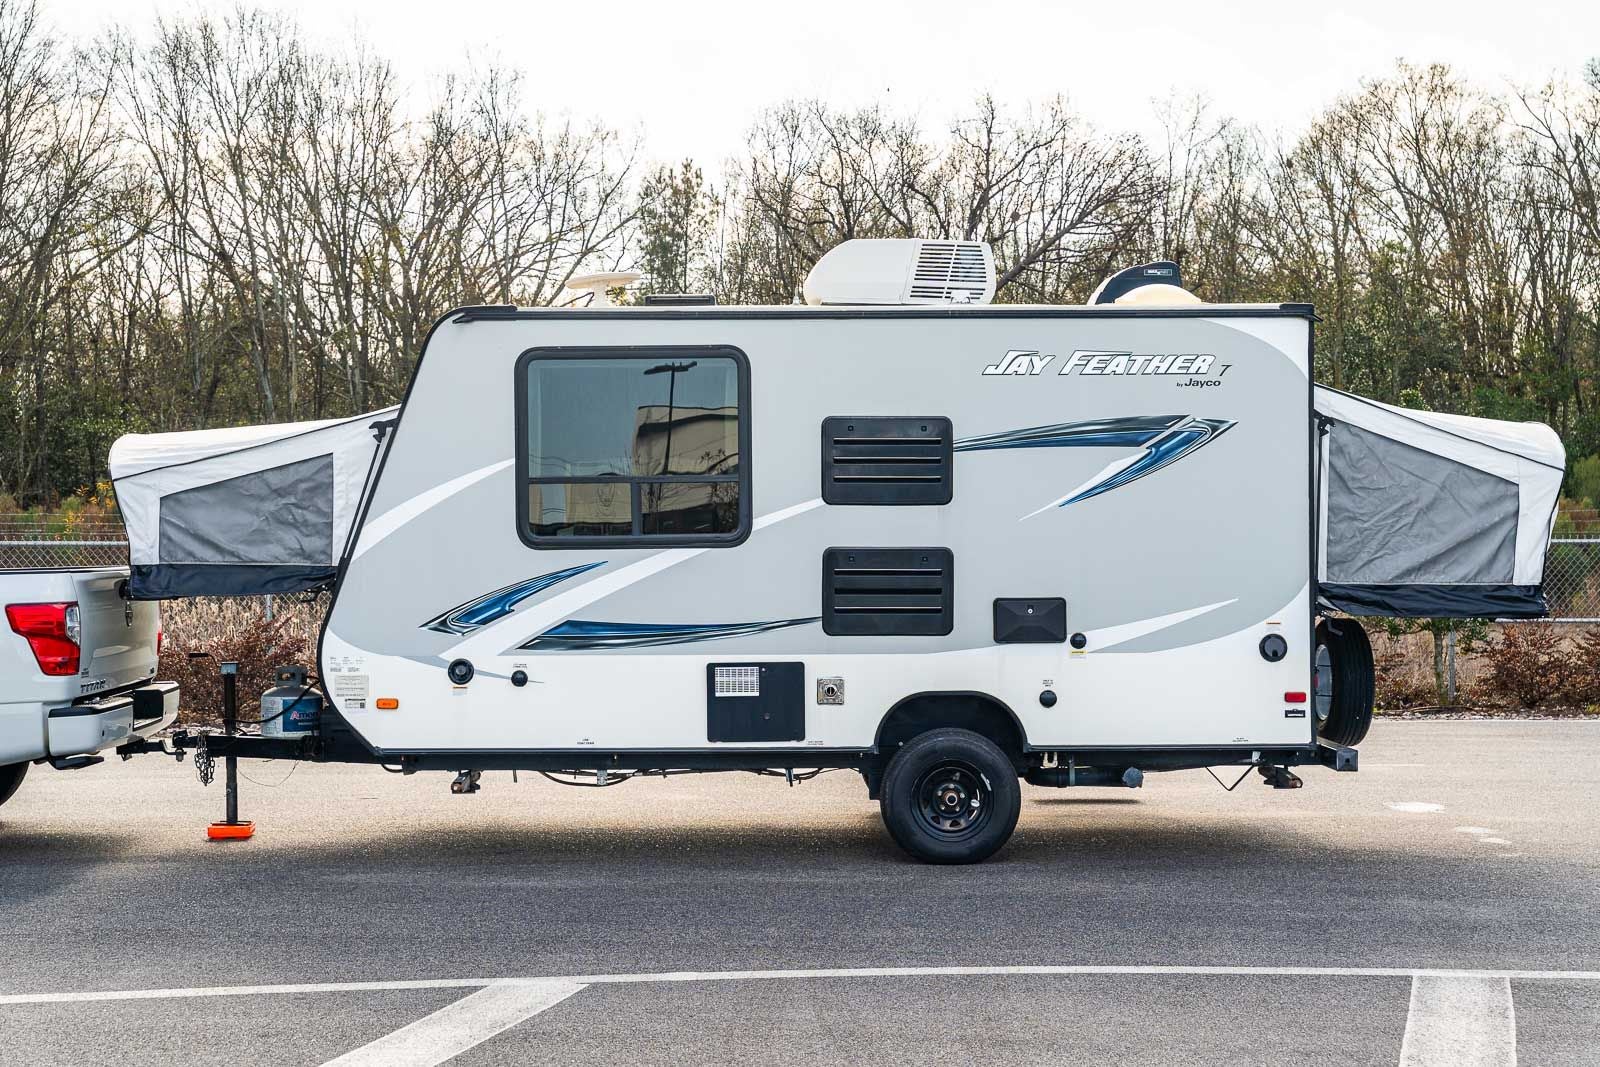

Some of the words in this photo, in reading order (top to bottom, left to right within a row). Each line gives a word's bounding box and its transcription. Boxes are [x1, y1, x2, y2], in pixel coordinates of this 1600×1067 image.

[982, 350, 1056, 375] JAY
[1058, 350, 1216, 375] FEATHER
[1219, 364, 1232, 376] 7
[1184, 378, 1221, 388] Jayco
[81, 680, 106, 693] TITAN
